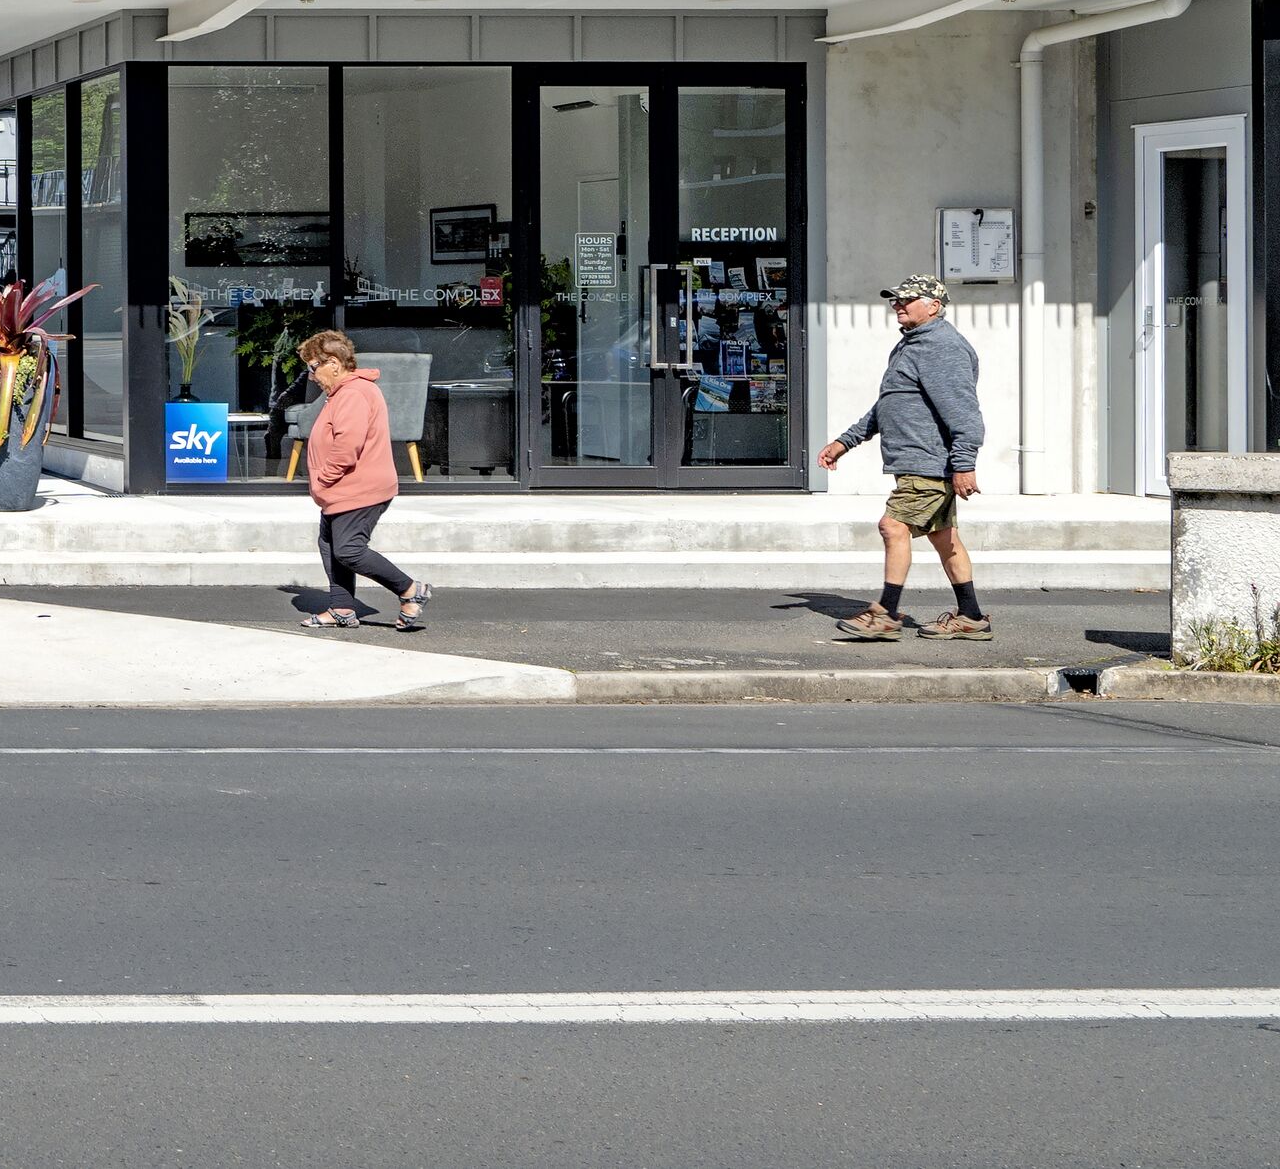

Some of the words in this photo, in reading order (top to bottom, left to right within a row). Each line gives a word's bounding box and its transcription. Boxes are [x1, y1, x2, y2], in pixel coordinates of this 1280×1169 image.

[691, 227, 777, 241] RECEPTION
[208, 288, 238, 300] THE
[389, 288, 419, 301] THE
[555, 292, 577, 301] THE
[694, 292, 716, 301] THE
[1168, 297, 1183, 305] THE
[173, 456, 202, 464] Available
[202, 456, 218, 464] here
